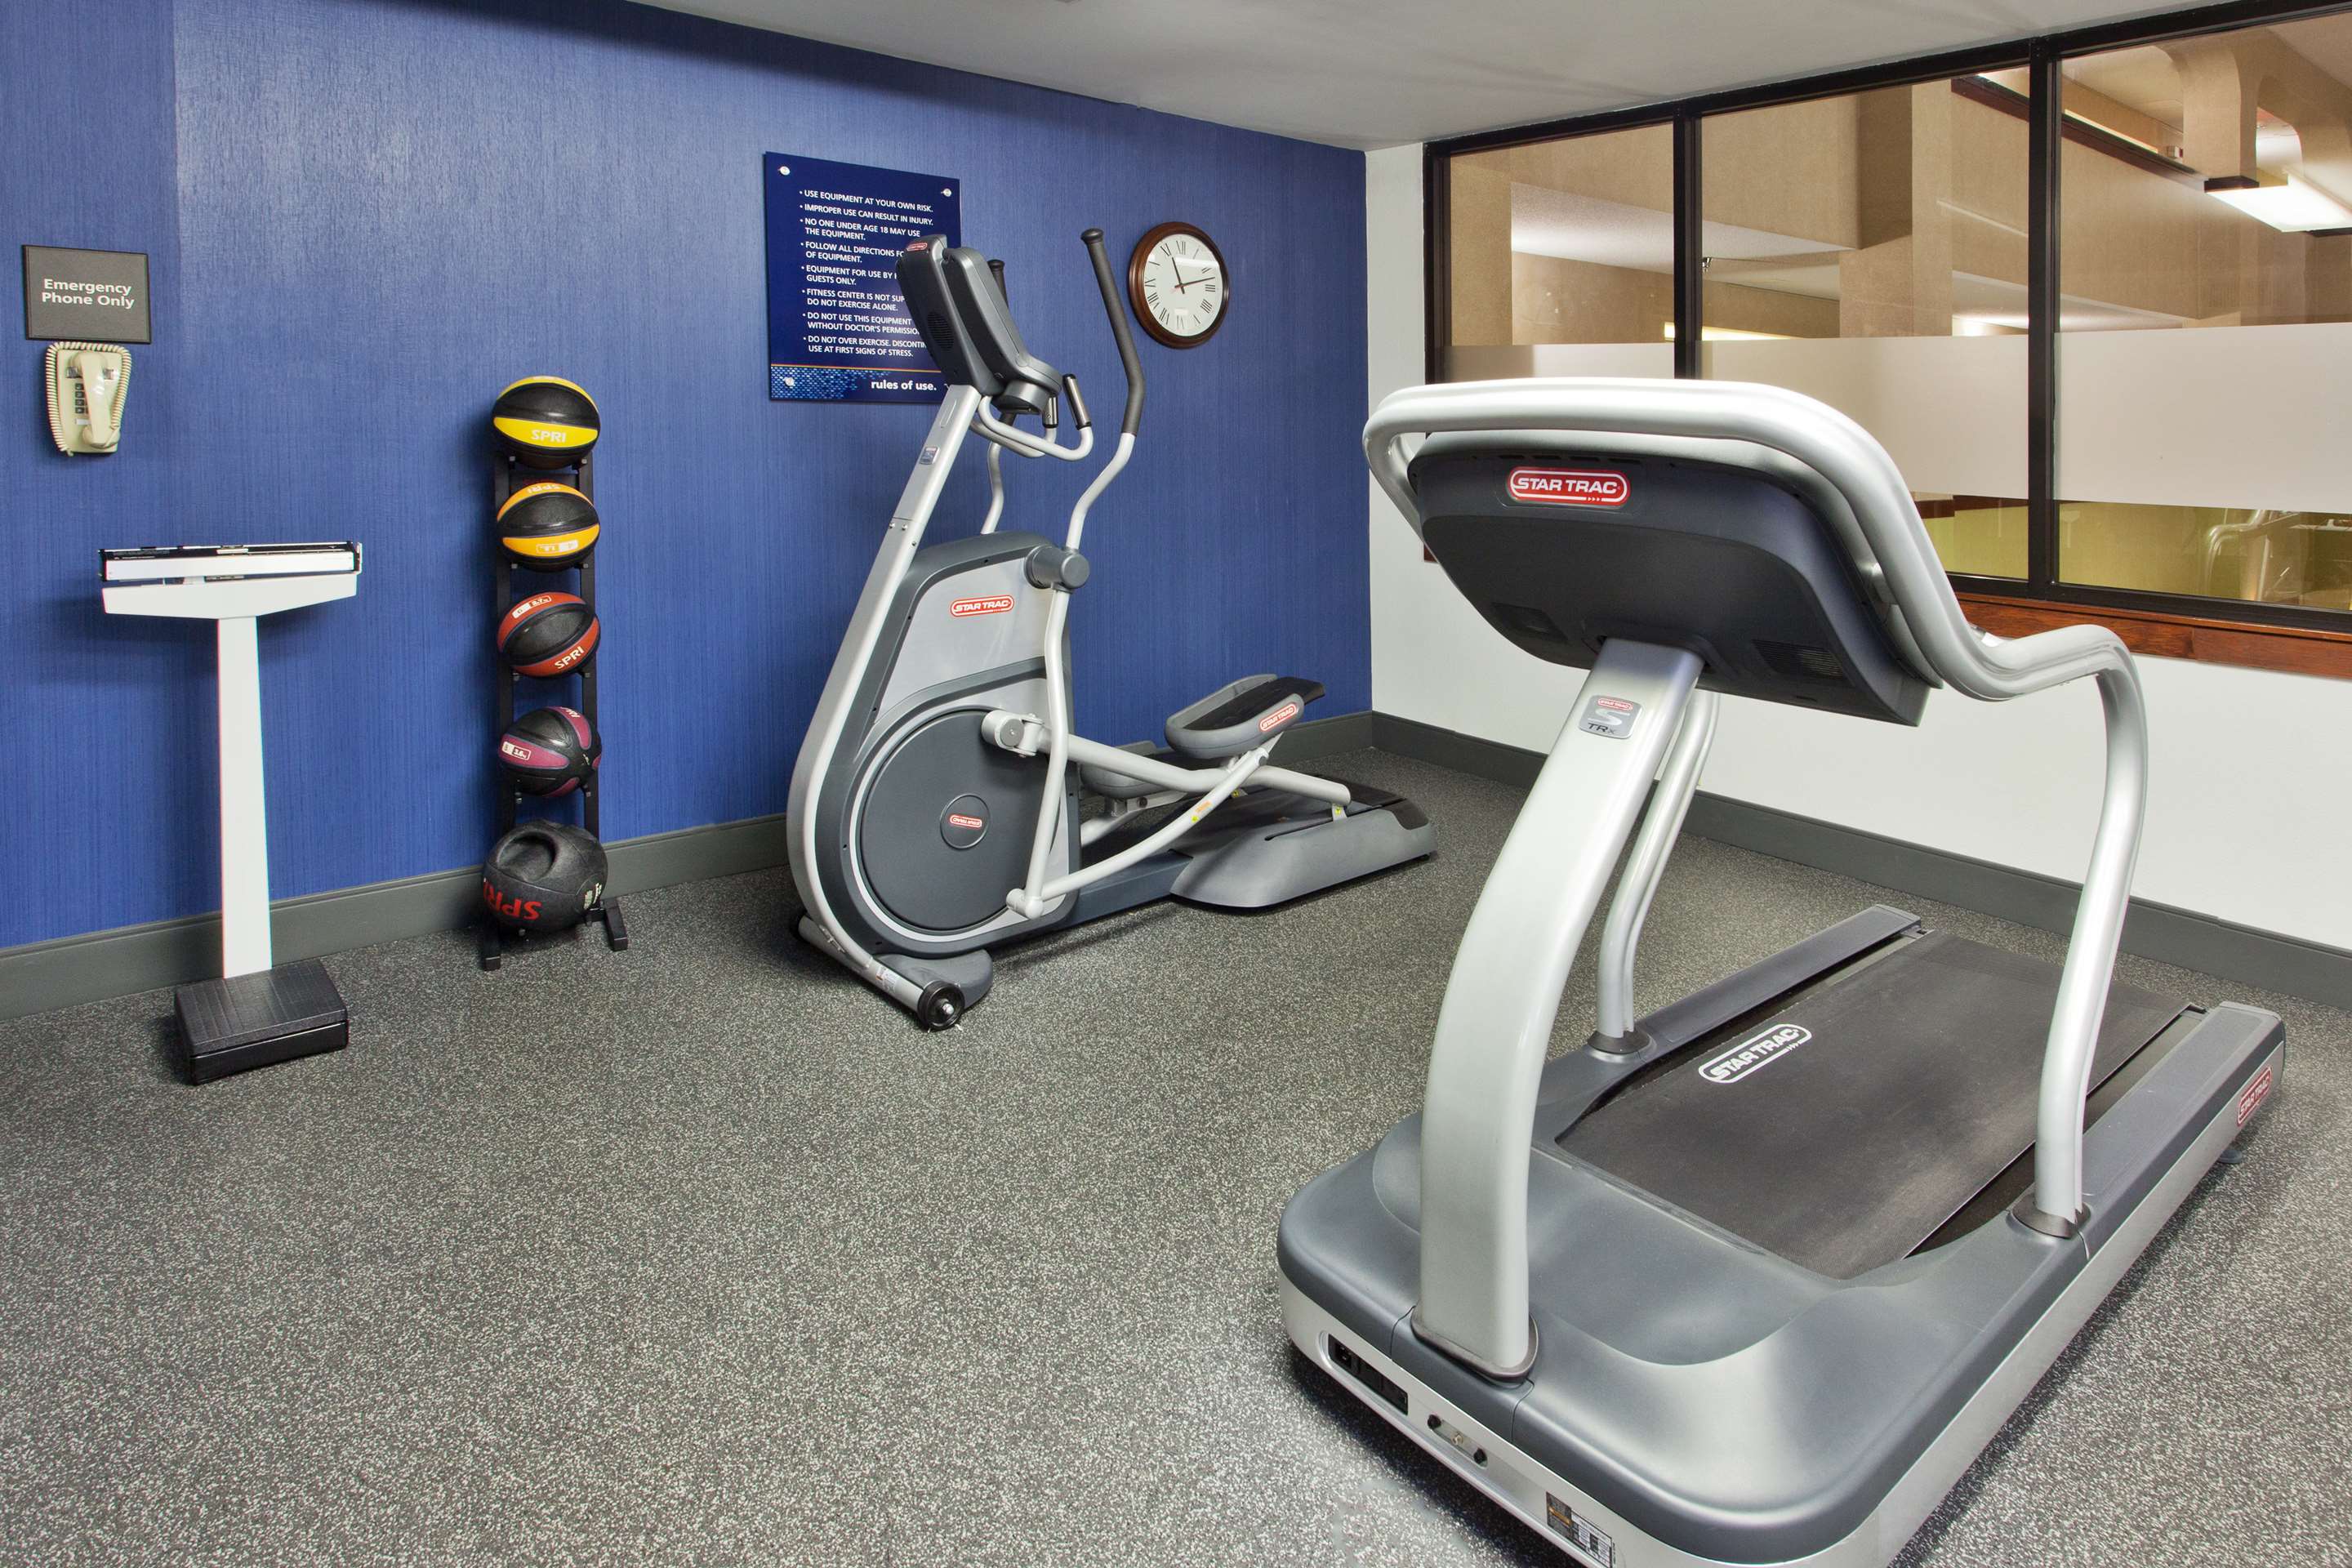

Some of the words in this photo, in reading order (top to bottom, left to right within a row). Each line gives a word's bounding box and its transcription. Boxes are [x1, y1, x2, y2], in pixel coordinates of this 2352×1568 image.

[821, 192, 862, 203] EQUIPMENT
[875, 199, 896, 207] YOUR
[898, 202, 915, 210] OWN
[804, 204, 841, 215] IMPROPER
[875, 212, 898, 221] RESULT
[910, 216, 933, 225] INJURY.
[818, 220, 835, 228] ONE
[836, 222, 861, 230] UNDER
[822, 229, 866, 240] EQUIPMENT.
[806, 242, 837, 251] FOLLOW
[839, 244, 852, 252] ALL
[853, 246, 894, 256] DIRECTIONS
[818, 252, 862, 263] EQUIPMENT.
[807, 265, 850, 276] EQUIPMENT
[852, 269, 866, 277] FOR
[807, 274, 835, 283] GUESTS
[836, 277, 856, 285] ONLY.
[44, 278, 131, 296] Emergency
[807, 288, 835, 296] FITNESS
[837, 291, 865, 300] CENTER
[42, 292, 92, 305] Phone
[98, 296, 135, 309] Only
[839, 301, 871, 310] EXERCISE
[872, 303, 898, 311] ALONE.
[871, 316, 911, 325] EQUIPMENT
[808, 322, 843, 331] WITHOUT
[845, 324, 880, 332] DOCTOR'S
[883, 326, 920, 334] PERMISSIO
[889, 349, 913, 357] STRESS.
[871, 381, 898, 390] rules
[901, 381, 913, 390] of
[915, 381, 937, 390] use.
[532, 430, 566, 443] SPRI
[1515, 478, 1562, 492] STAR
[1566, 479, 1617, 494] TRAC
[953, 604, 981, 612] STAR
[982, 599, 1010, 608] TRAC
[554, 645, 585, 669] SPRI
[1710, 1051, 1759, 1080] STAR
[1749, 1029, 1799, 1055] TRAC
